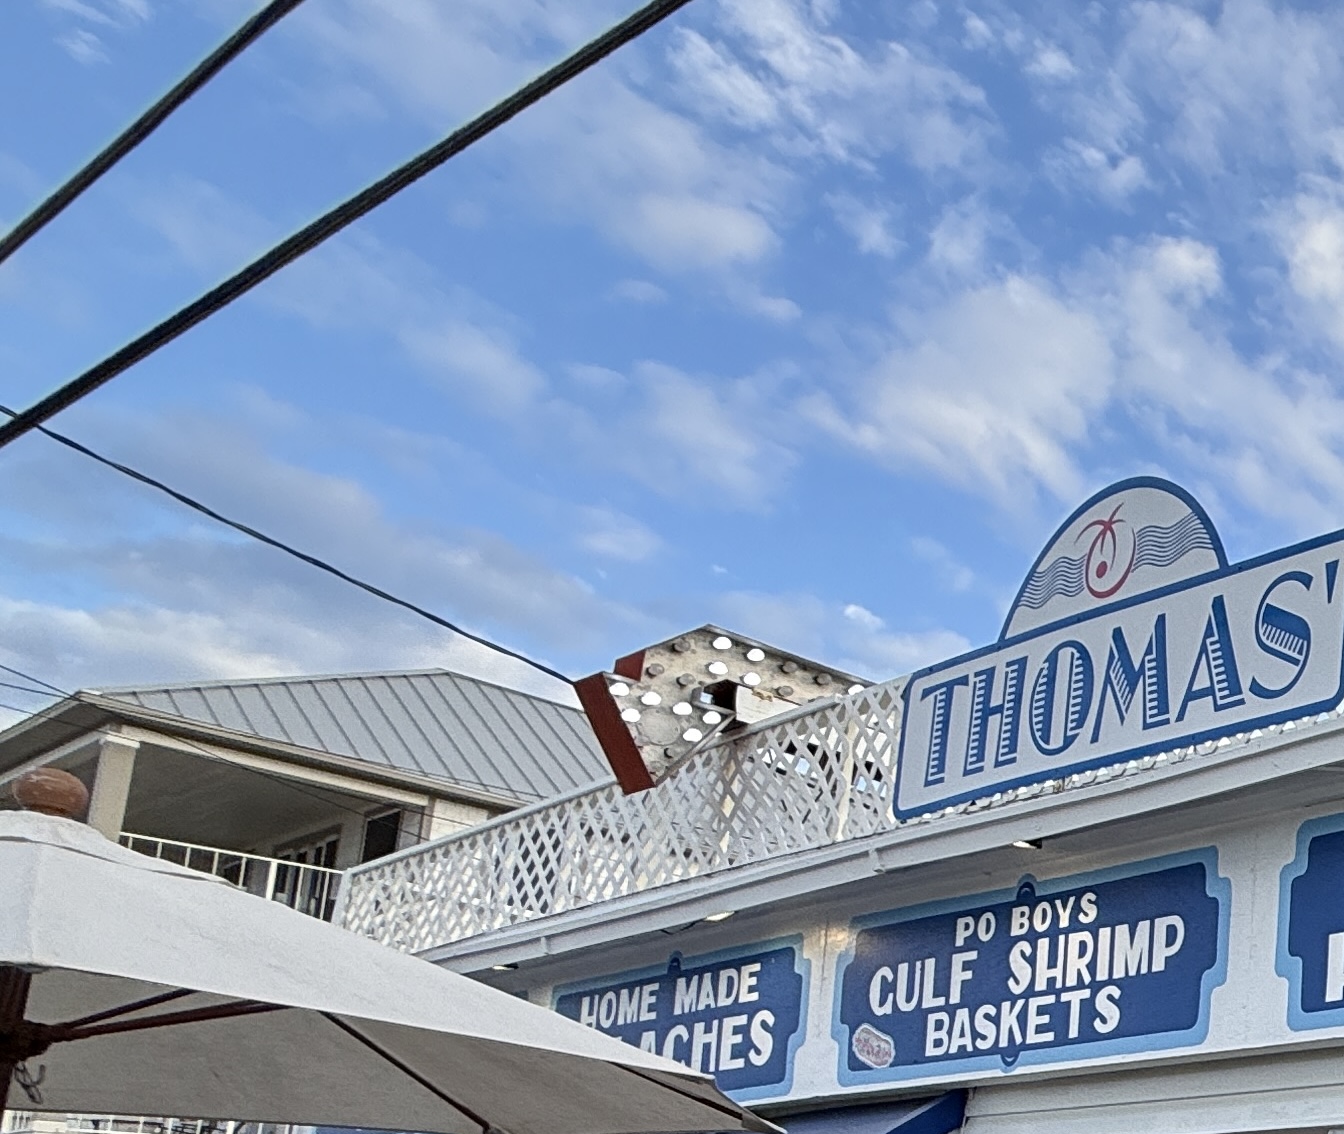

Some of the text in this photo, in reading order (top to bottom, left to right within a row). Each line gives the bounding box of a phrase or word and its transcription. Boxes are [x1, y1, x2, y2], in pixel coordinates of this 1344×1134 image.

[921, 559, 1339, 788] THOMAS'
[955, 892, 1098, 947] PO BOYS
[580, 963, 761, 1029] HOME MADE
[869, 914, 1185, 1017] GULF SHRIMP
[925, 985, 1122, 1057] BASKETS
